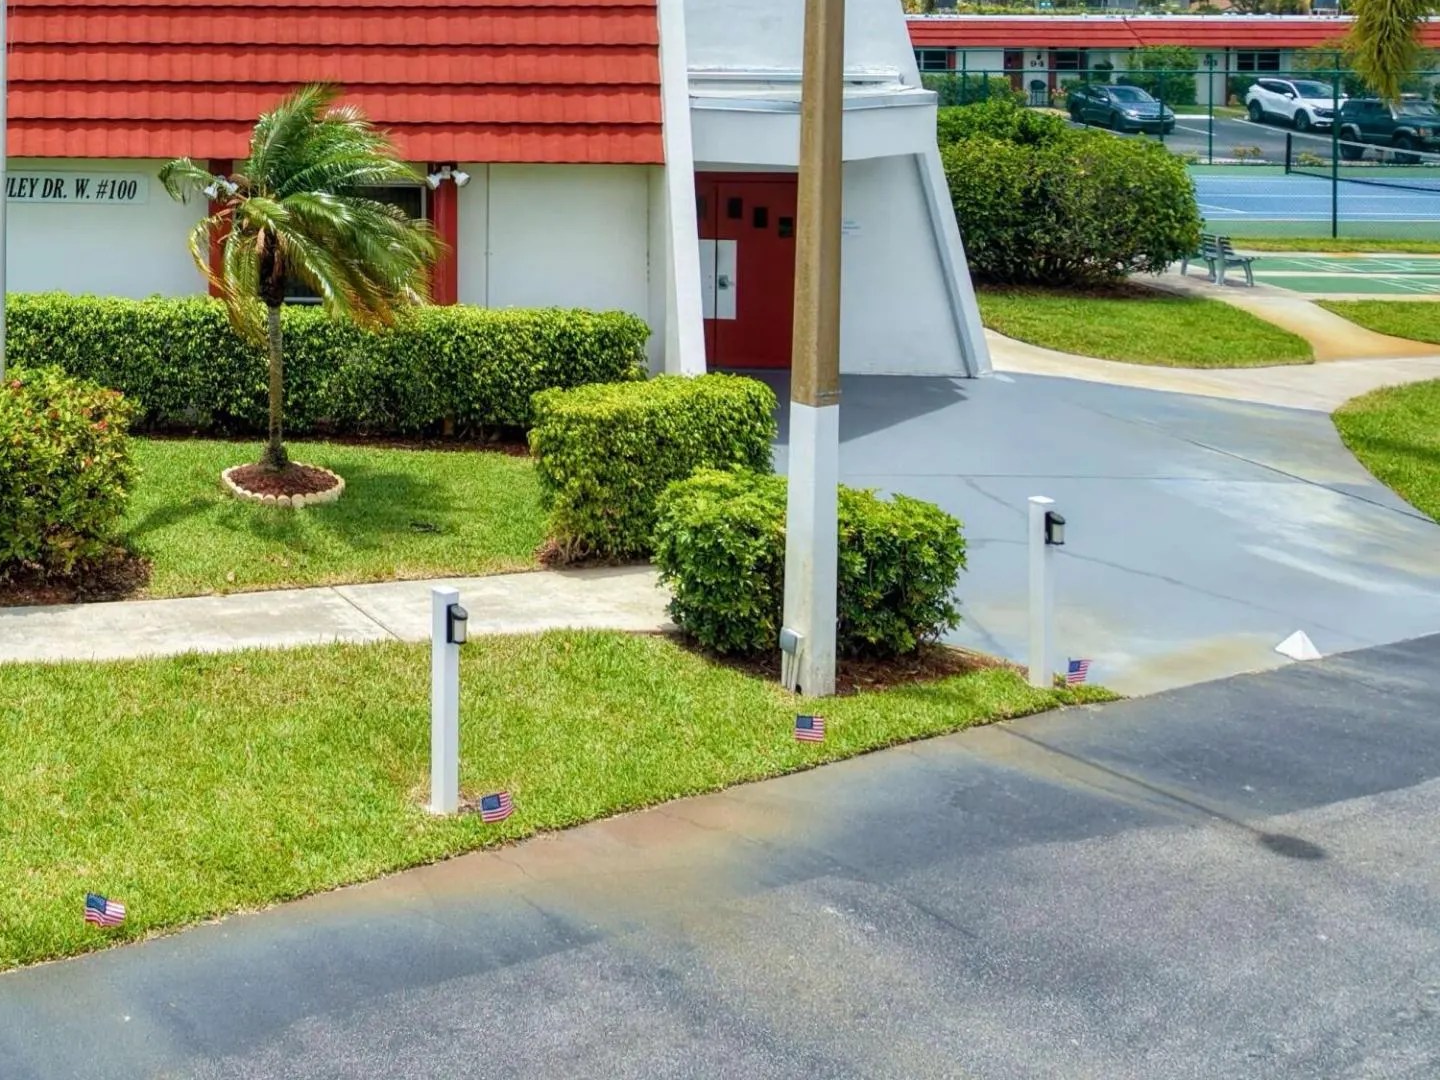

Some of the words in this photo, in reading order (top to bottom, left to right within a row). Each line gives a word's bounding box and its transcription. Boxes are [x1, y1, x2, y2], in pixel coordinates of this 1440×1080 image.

[41, 178, 67, 198] DR.
[75, 179, 90, 199] W.
[96, 180, 137, 199] #100
